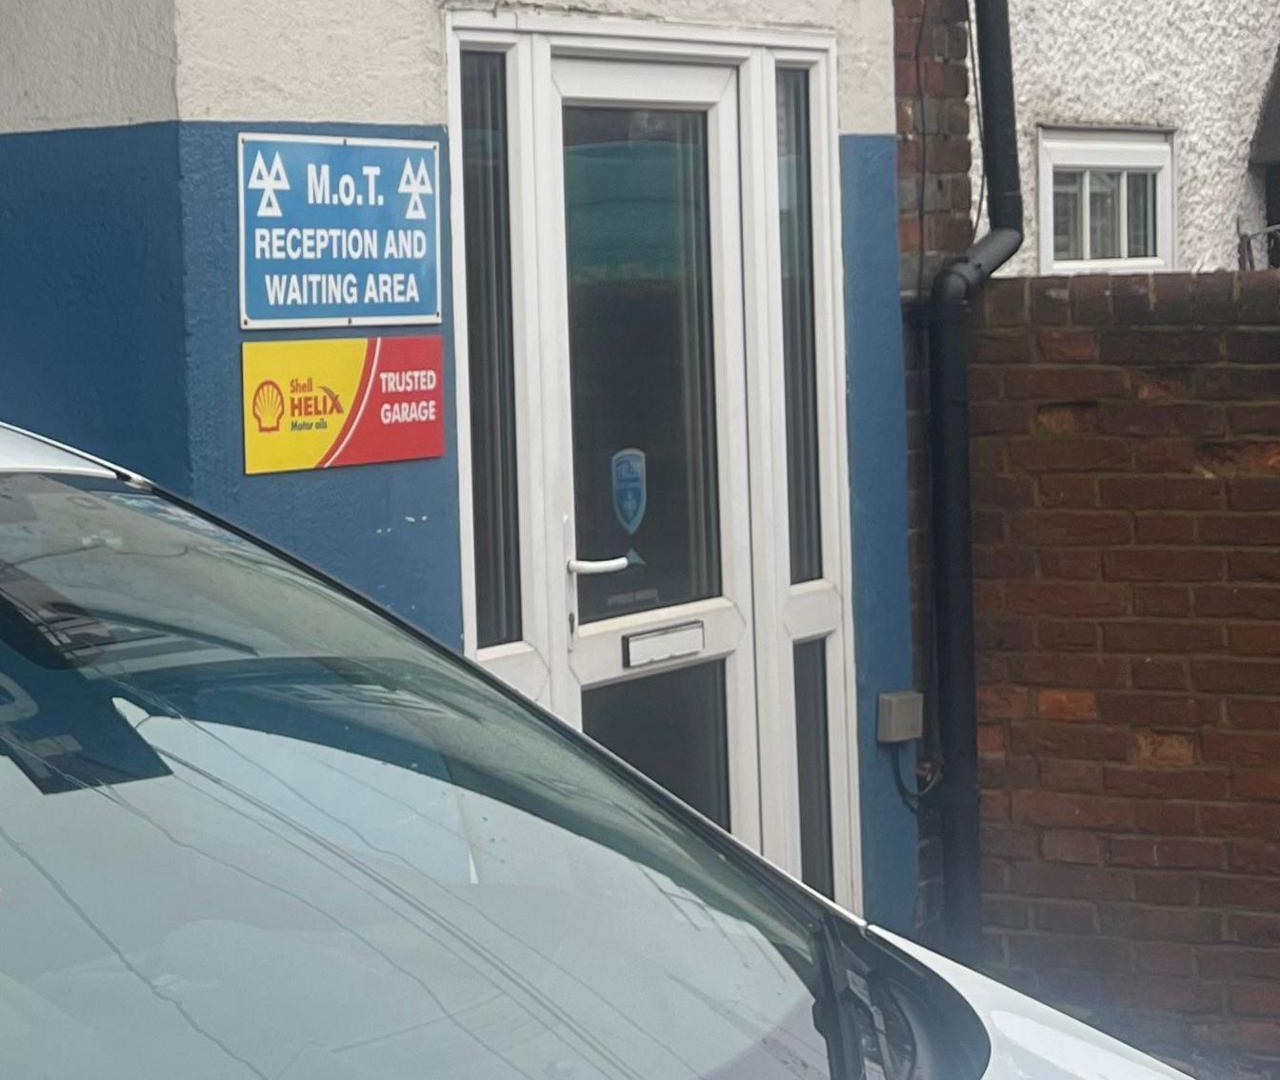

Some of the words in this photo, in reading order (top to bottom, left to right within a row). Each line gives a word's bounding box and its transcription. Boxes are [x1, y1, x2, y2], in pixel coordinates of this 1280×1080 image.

[306, 163, 385, 206] M.o.T.
[254, 228, 378, 260] RECEPTION
[384, 229, 427, 259] AND
[265, 274, 358, 306] WAITING
[363, 273, 420, 304] AREA
[290, 378, 313, 394] Shell
[380, 370, 437, 393] TRUSTED
[290, 385, 345, 417] HELIX
[380, 400, 437, 425] GARAGE
[291, 419, 314, 431] Motor
[315, 418, 328, 430] oils
